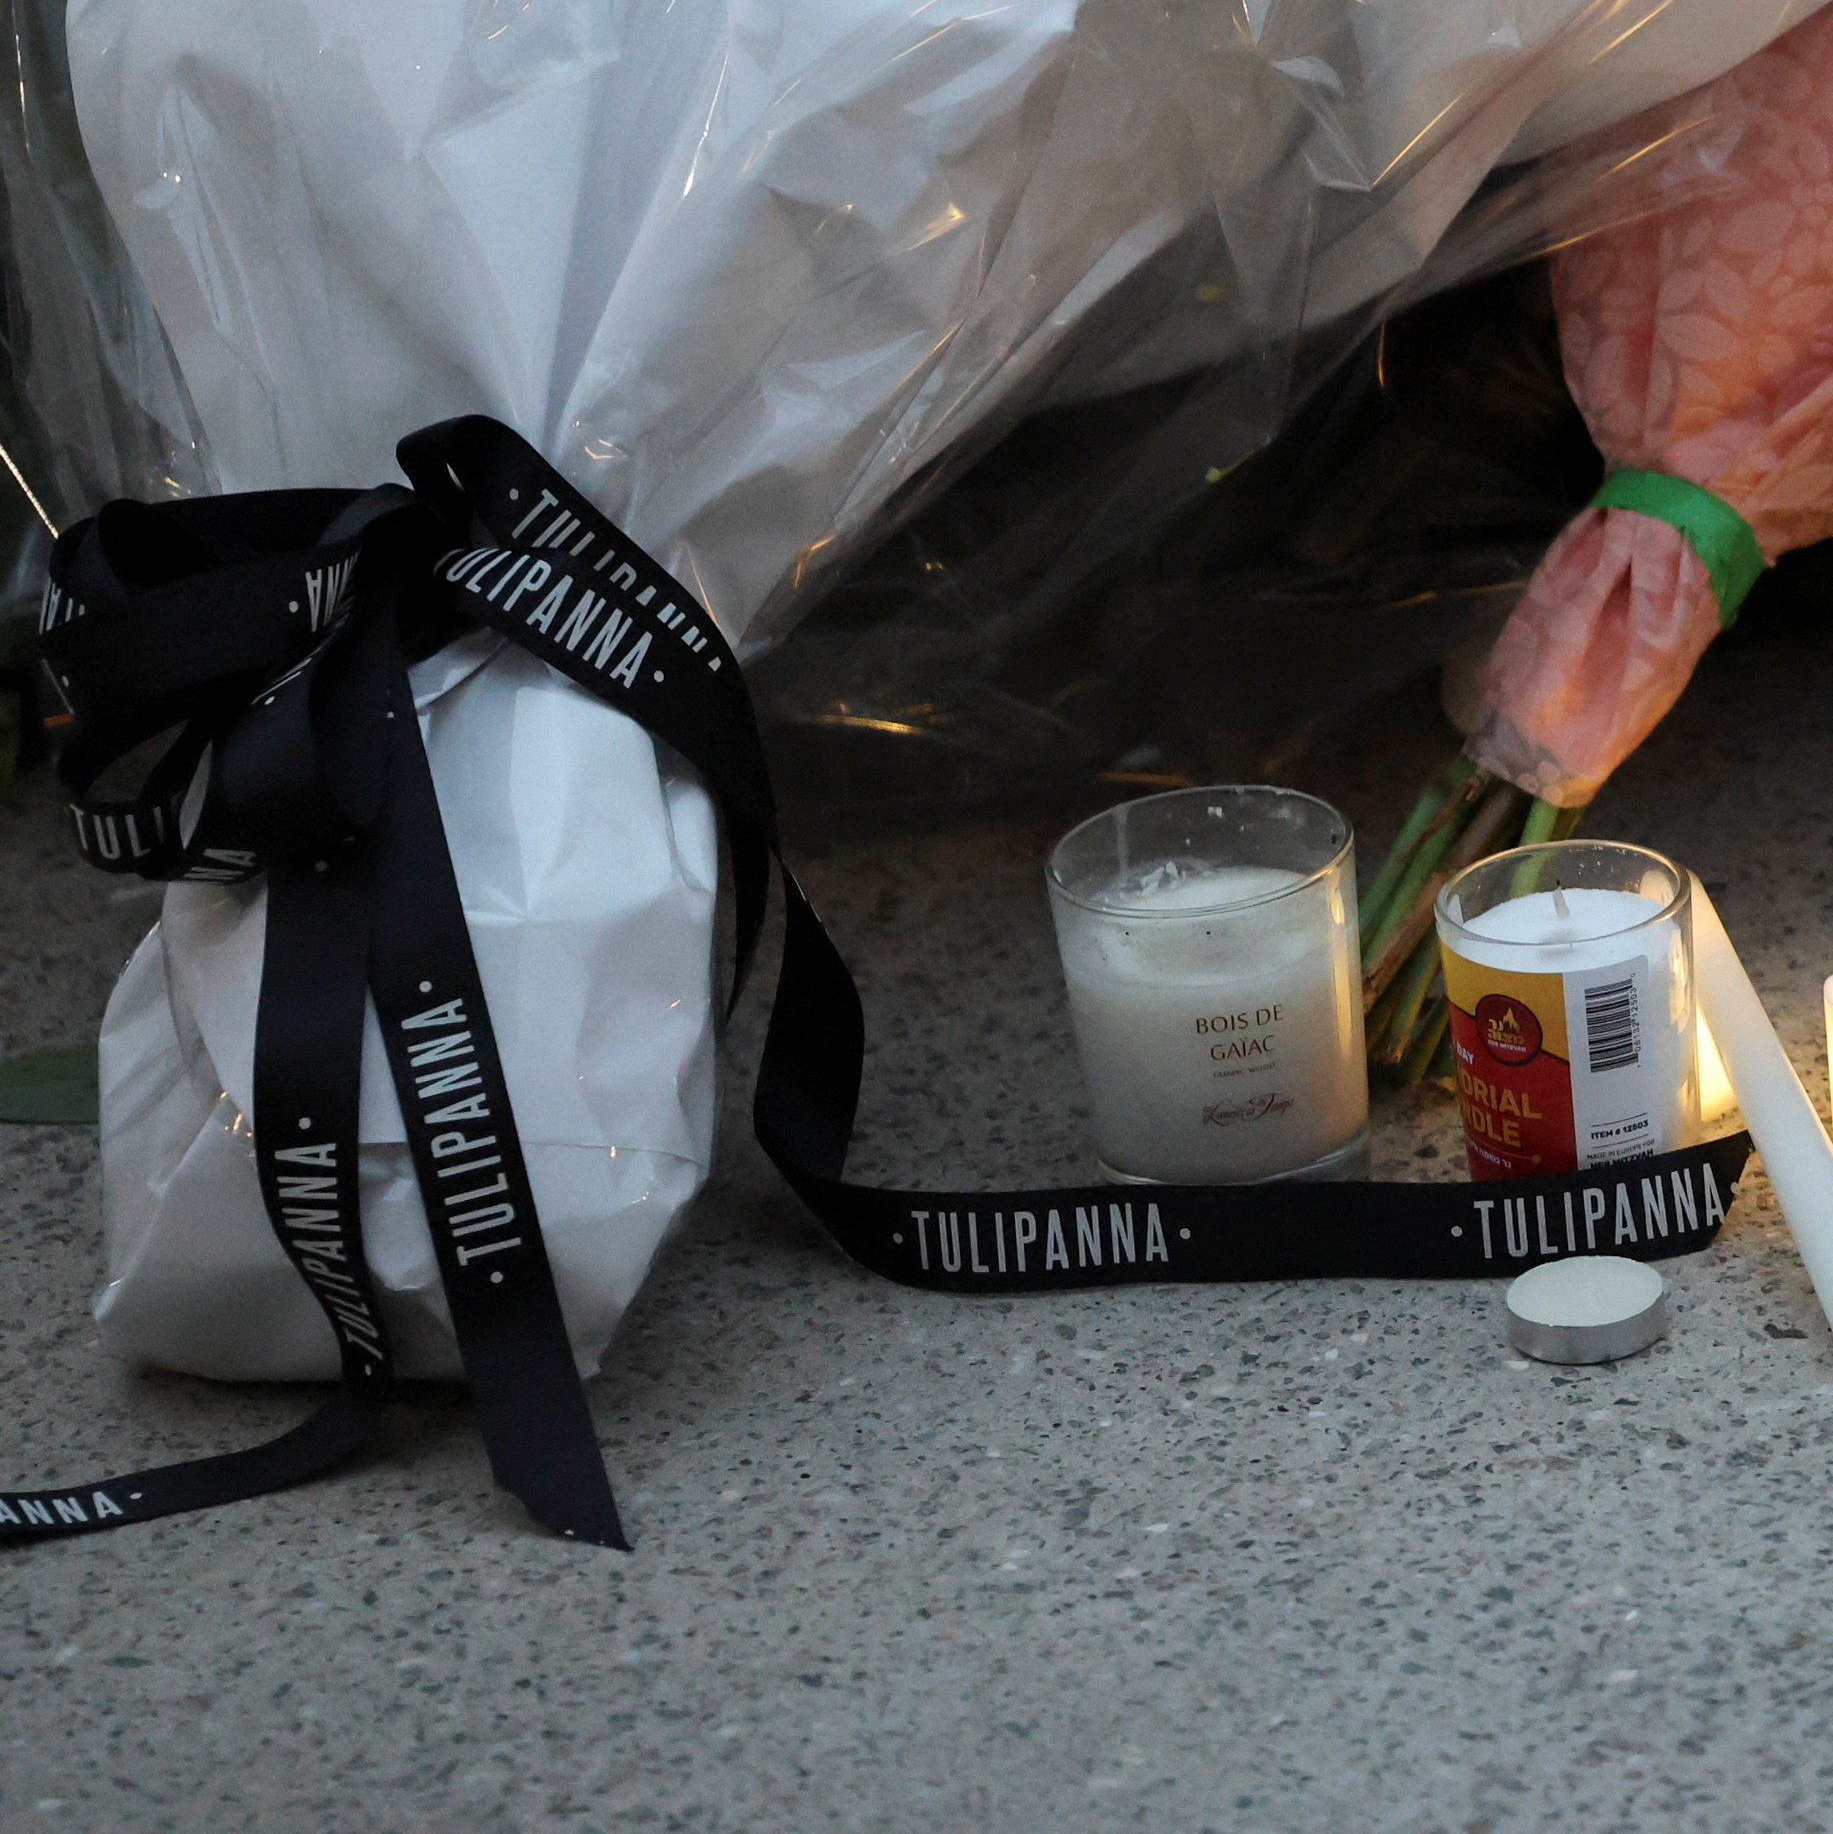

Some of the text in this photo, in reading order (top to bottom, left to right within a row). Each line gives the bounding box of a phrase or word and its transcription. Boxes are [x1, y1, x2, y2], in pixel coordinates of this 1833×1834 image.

[434, 547, 653, 689] ULIPANNA
[1195, 1004, 1283, 1035] BOIS DE
[1210, 1035, 1275, 1061] GAÏAC
[1457, 1044, 1475, 1066] DAY
[1459, 1068, 1543, 1120] ORIAL
[401, 997, 522, 1267] TULIPANNA
[1461, 1102, 1521, 1149] NDLE
[1590, 1128, 1614, 1140] ITEM
[1622, 1119, 1650, 1134] 12503
[1474, 1162, 1725, 1260] TULIPANNA
[274, 1142, 384, 1363] TULIPANNA
[911, 1202, 1169, 1273] TULIPANNA
